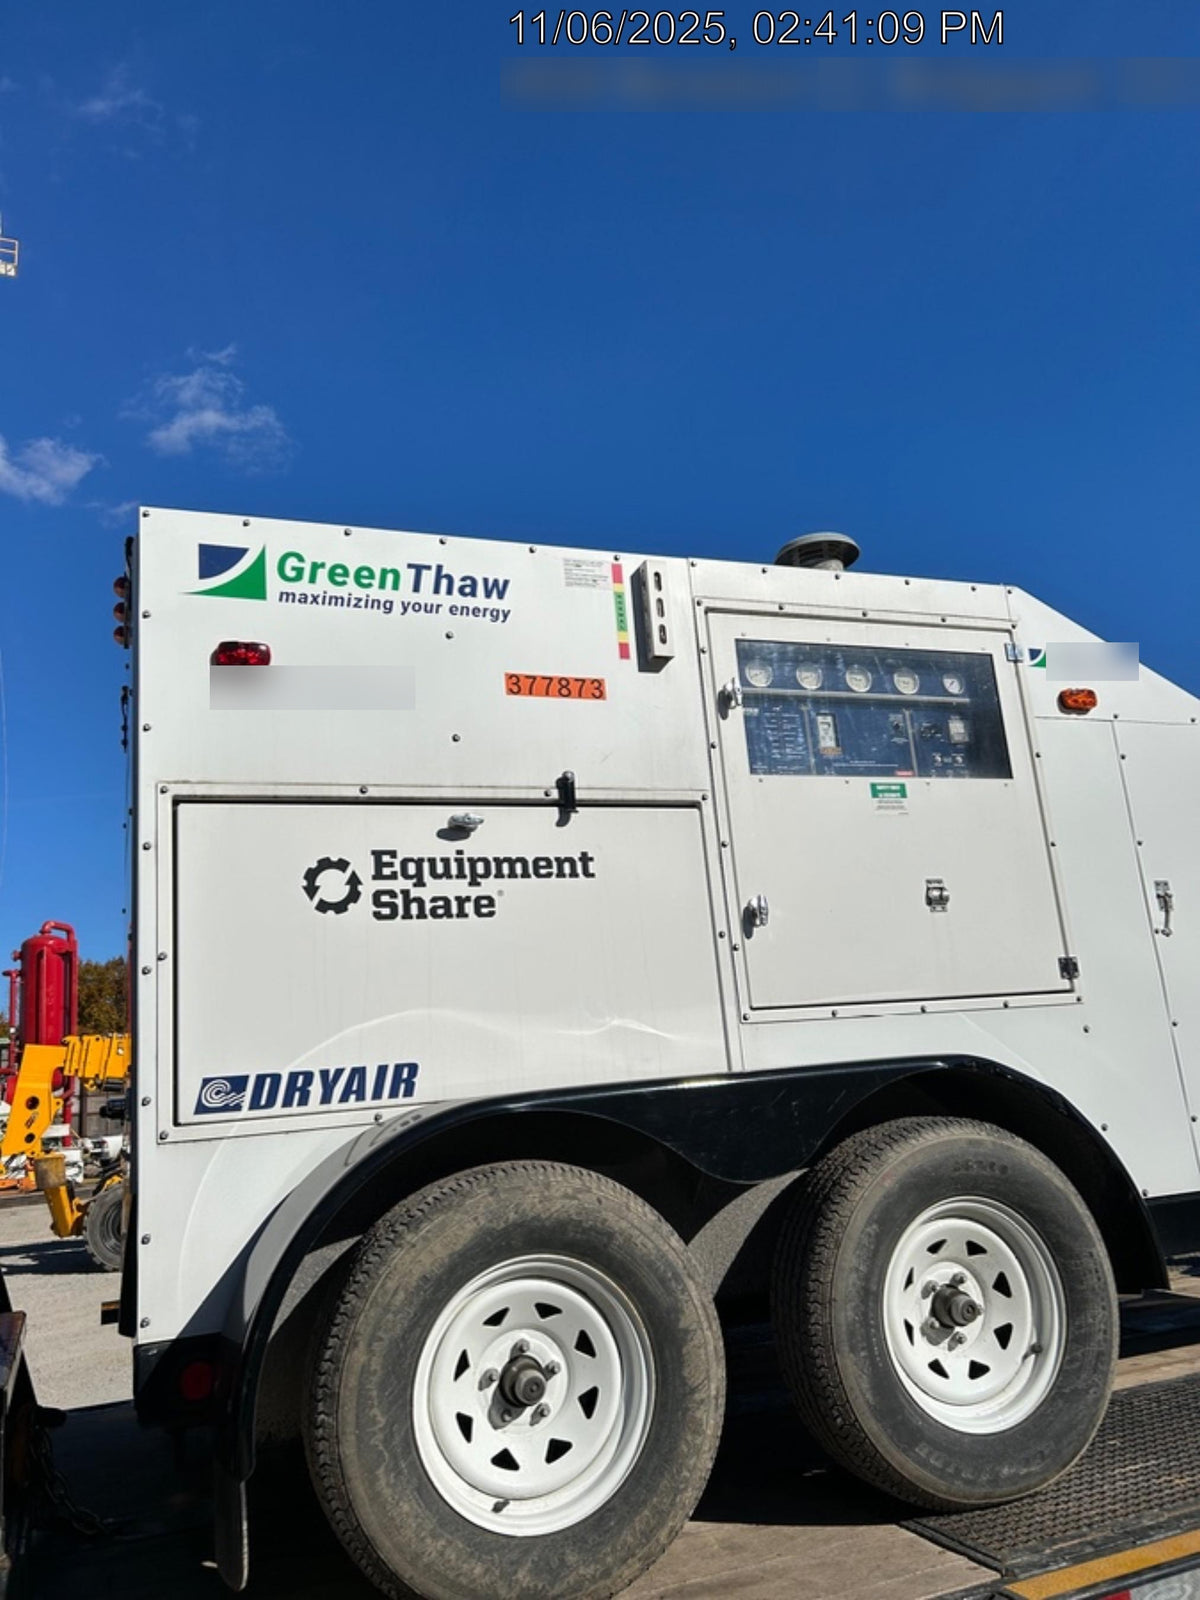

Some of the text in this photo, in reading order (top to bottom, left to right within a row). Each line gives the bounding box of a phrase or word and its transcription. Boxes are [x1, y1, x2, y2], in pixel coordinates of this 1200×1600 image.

[278, 589, 512, 623] maximizing your energy
[507, 673, 605, 699] 377873
[371, 849, 596, 888] Equipment
[371, 889, 496, 921] Share
[248, 1062, 420, 1111] DRYAIR
